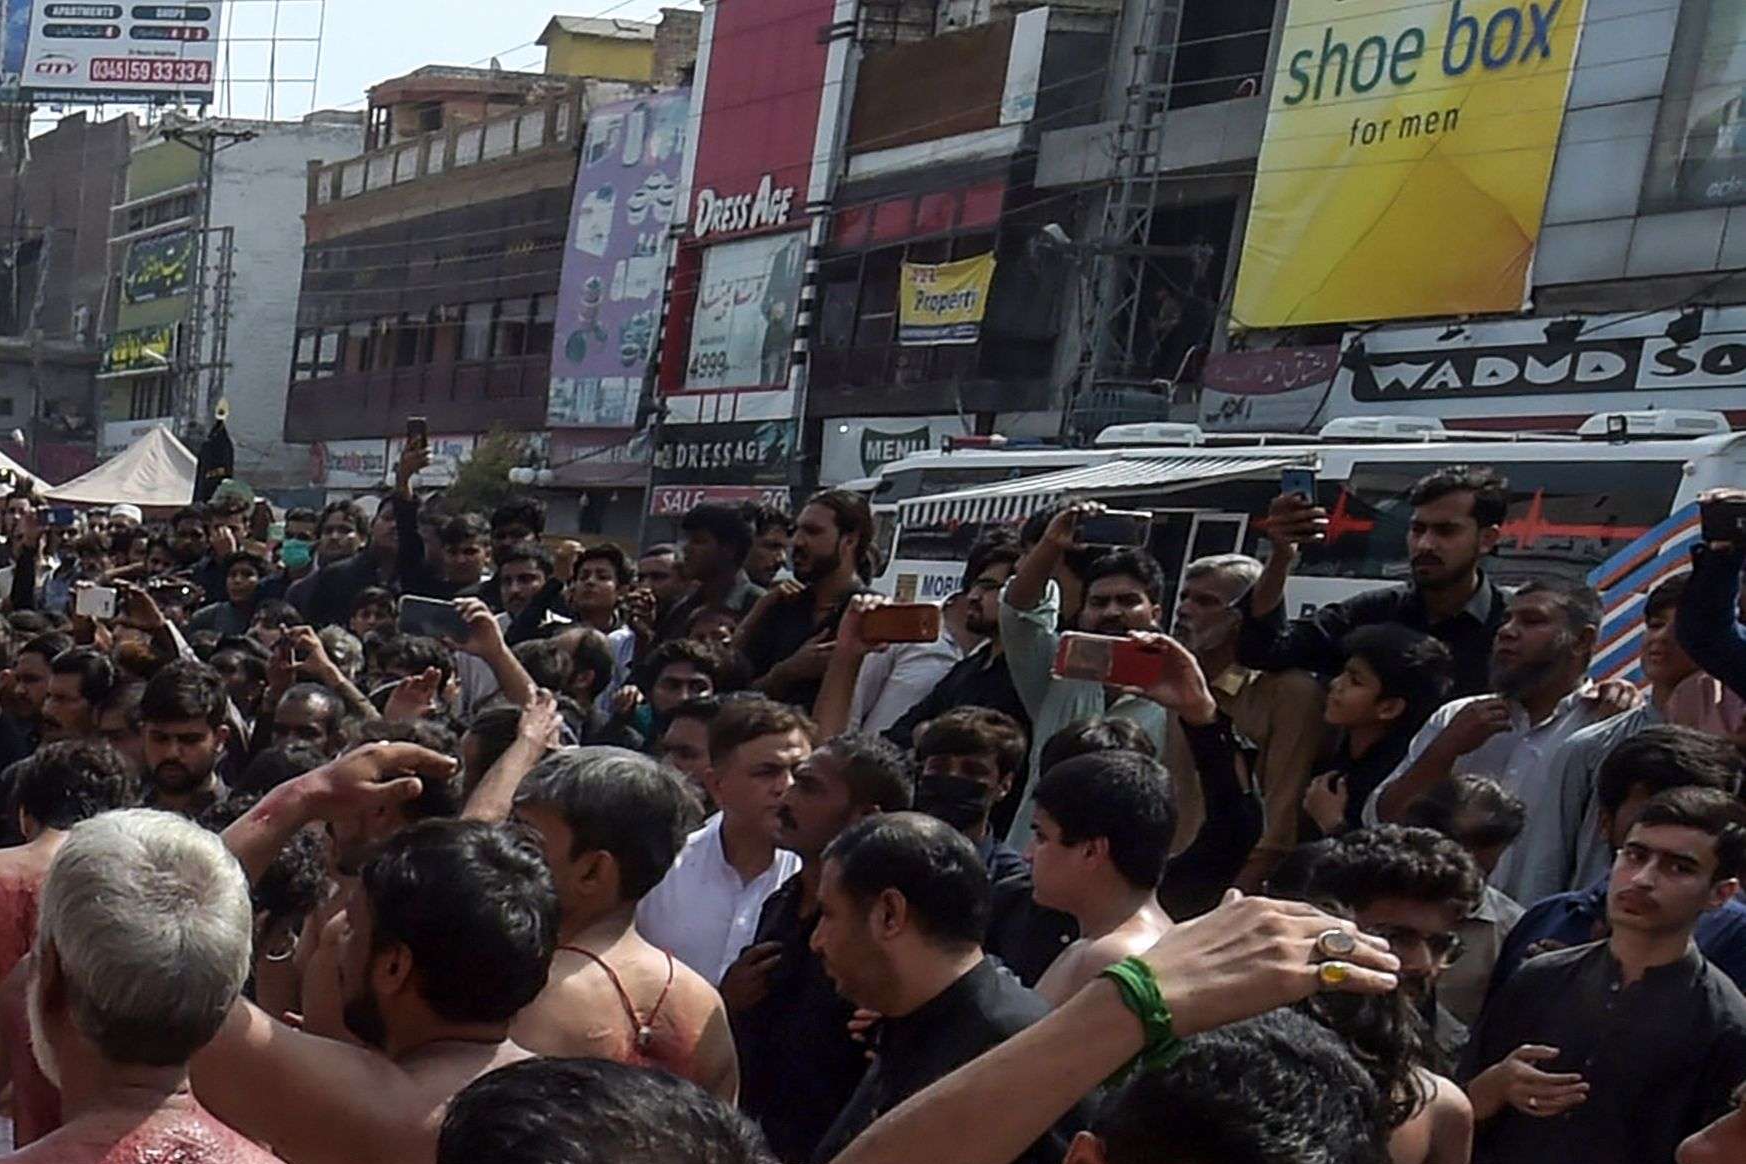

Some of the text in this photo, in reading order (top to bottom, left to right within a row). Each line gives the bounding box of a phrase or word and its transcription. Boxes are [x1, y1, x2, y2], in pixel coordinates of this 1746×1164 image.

[34, 62, 78, 75] CITY
[1282, 0, 1561, 106] shoe box
[1349, 107, 1460, 147] for men
[1369, 350, 1626, 392] WADUD
[920, 574, 963, 597] MOBI
